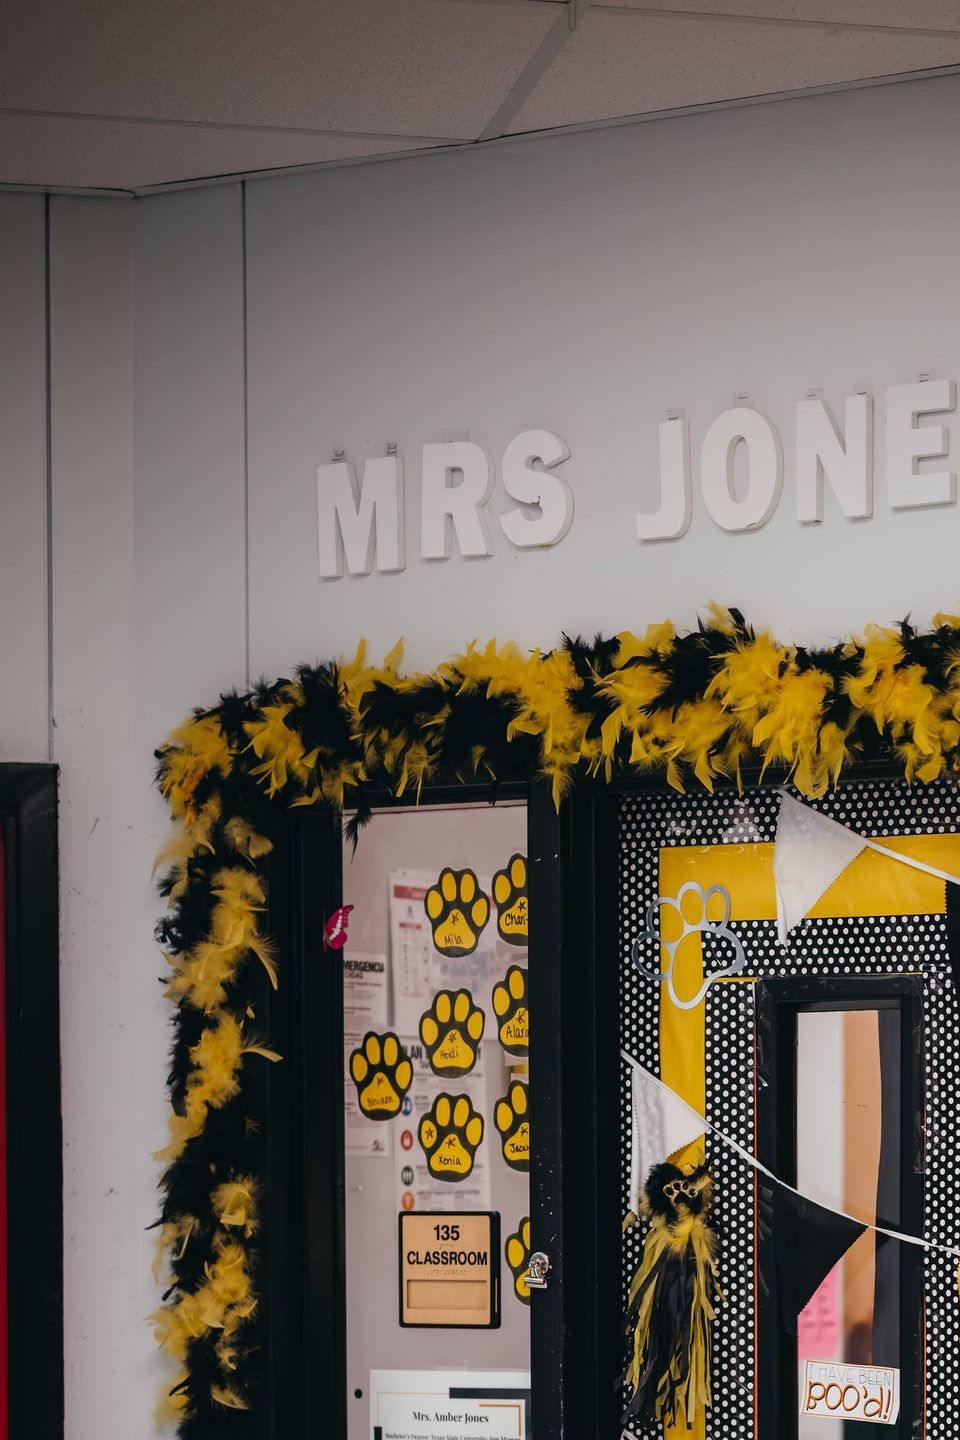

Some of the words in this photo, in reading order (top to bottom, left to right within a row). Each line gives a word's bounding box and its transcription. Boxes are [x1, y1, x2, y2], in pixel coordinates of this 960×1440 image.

[316, 429, 575, 578] MRS
[444, 933, 463, 945] Mila
[440, 1047, 459, 1060] Heidi
[439, 1154, 461, 1166] Xenia
[433, 1224, 460, 1241] 135
[407, 1251, 487, 1265] CLASSROOM
[819, 1366, 853, 1383] HAVE
[859, 1369, 890, 1386] BEEN
[413, 1411, 432, 1421] Mrs.
[434, 1412, 463, 1422] Amber
[464, 1413, 489, 1424] Jones
